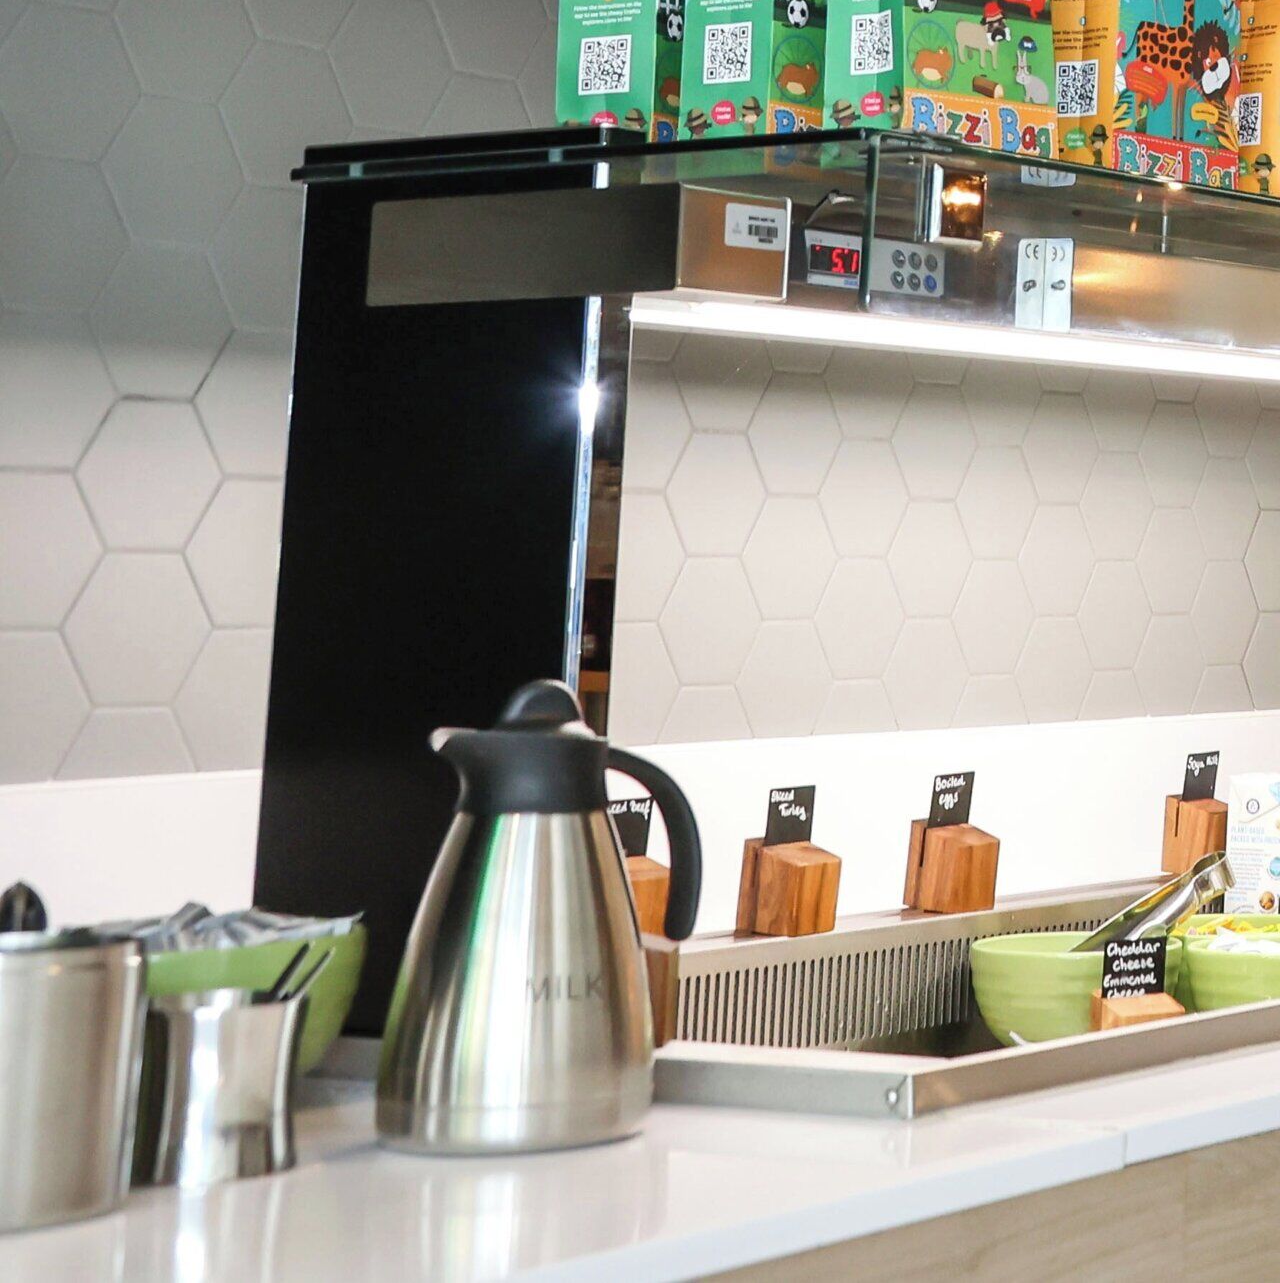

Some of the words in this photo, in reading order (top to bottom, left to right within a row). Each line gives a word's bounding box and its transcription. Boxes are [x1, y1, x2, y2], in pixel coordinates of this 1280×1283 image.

[910, 94, 993, 146] Bizzi
[998, 105, 1052, 159] Bag
[1107, 941, 1161, 957] Cheddar
[526, 975, 601, 1002] MILK
[1103, 971, 1157, 988] Emmental
